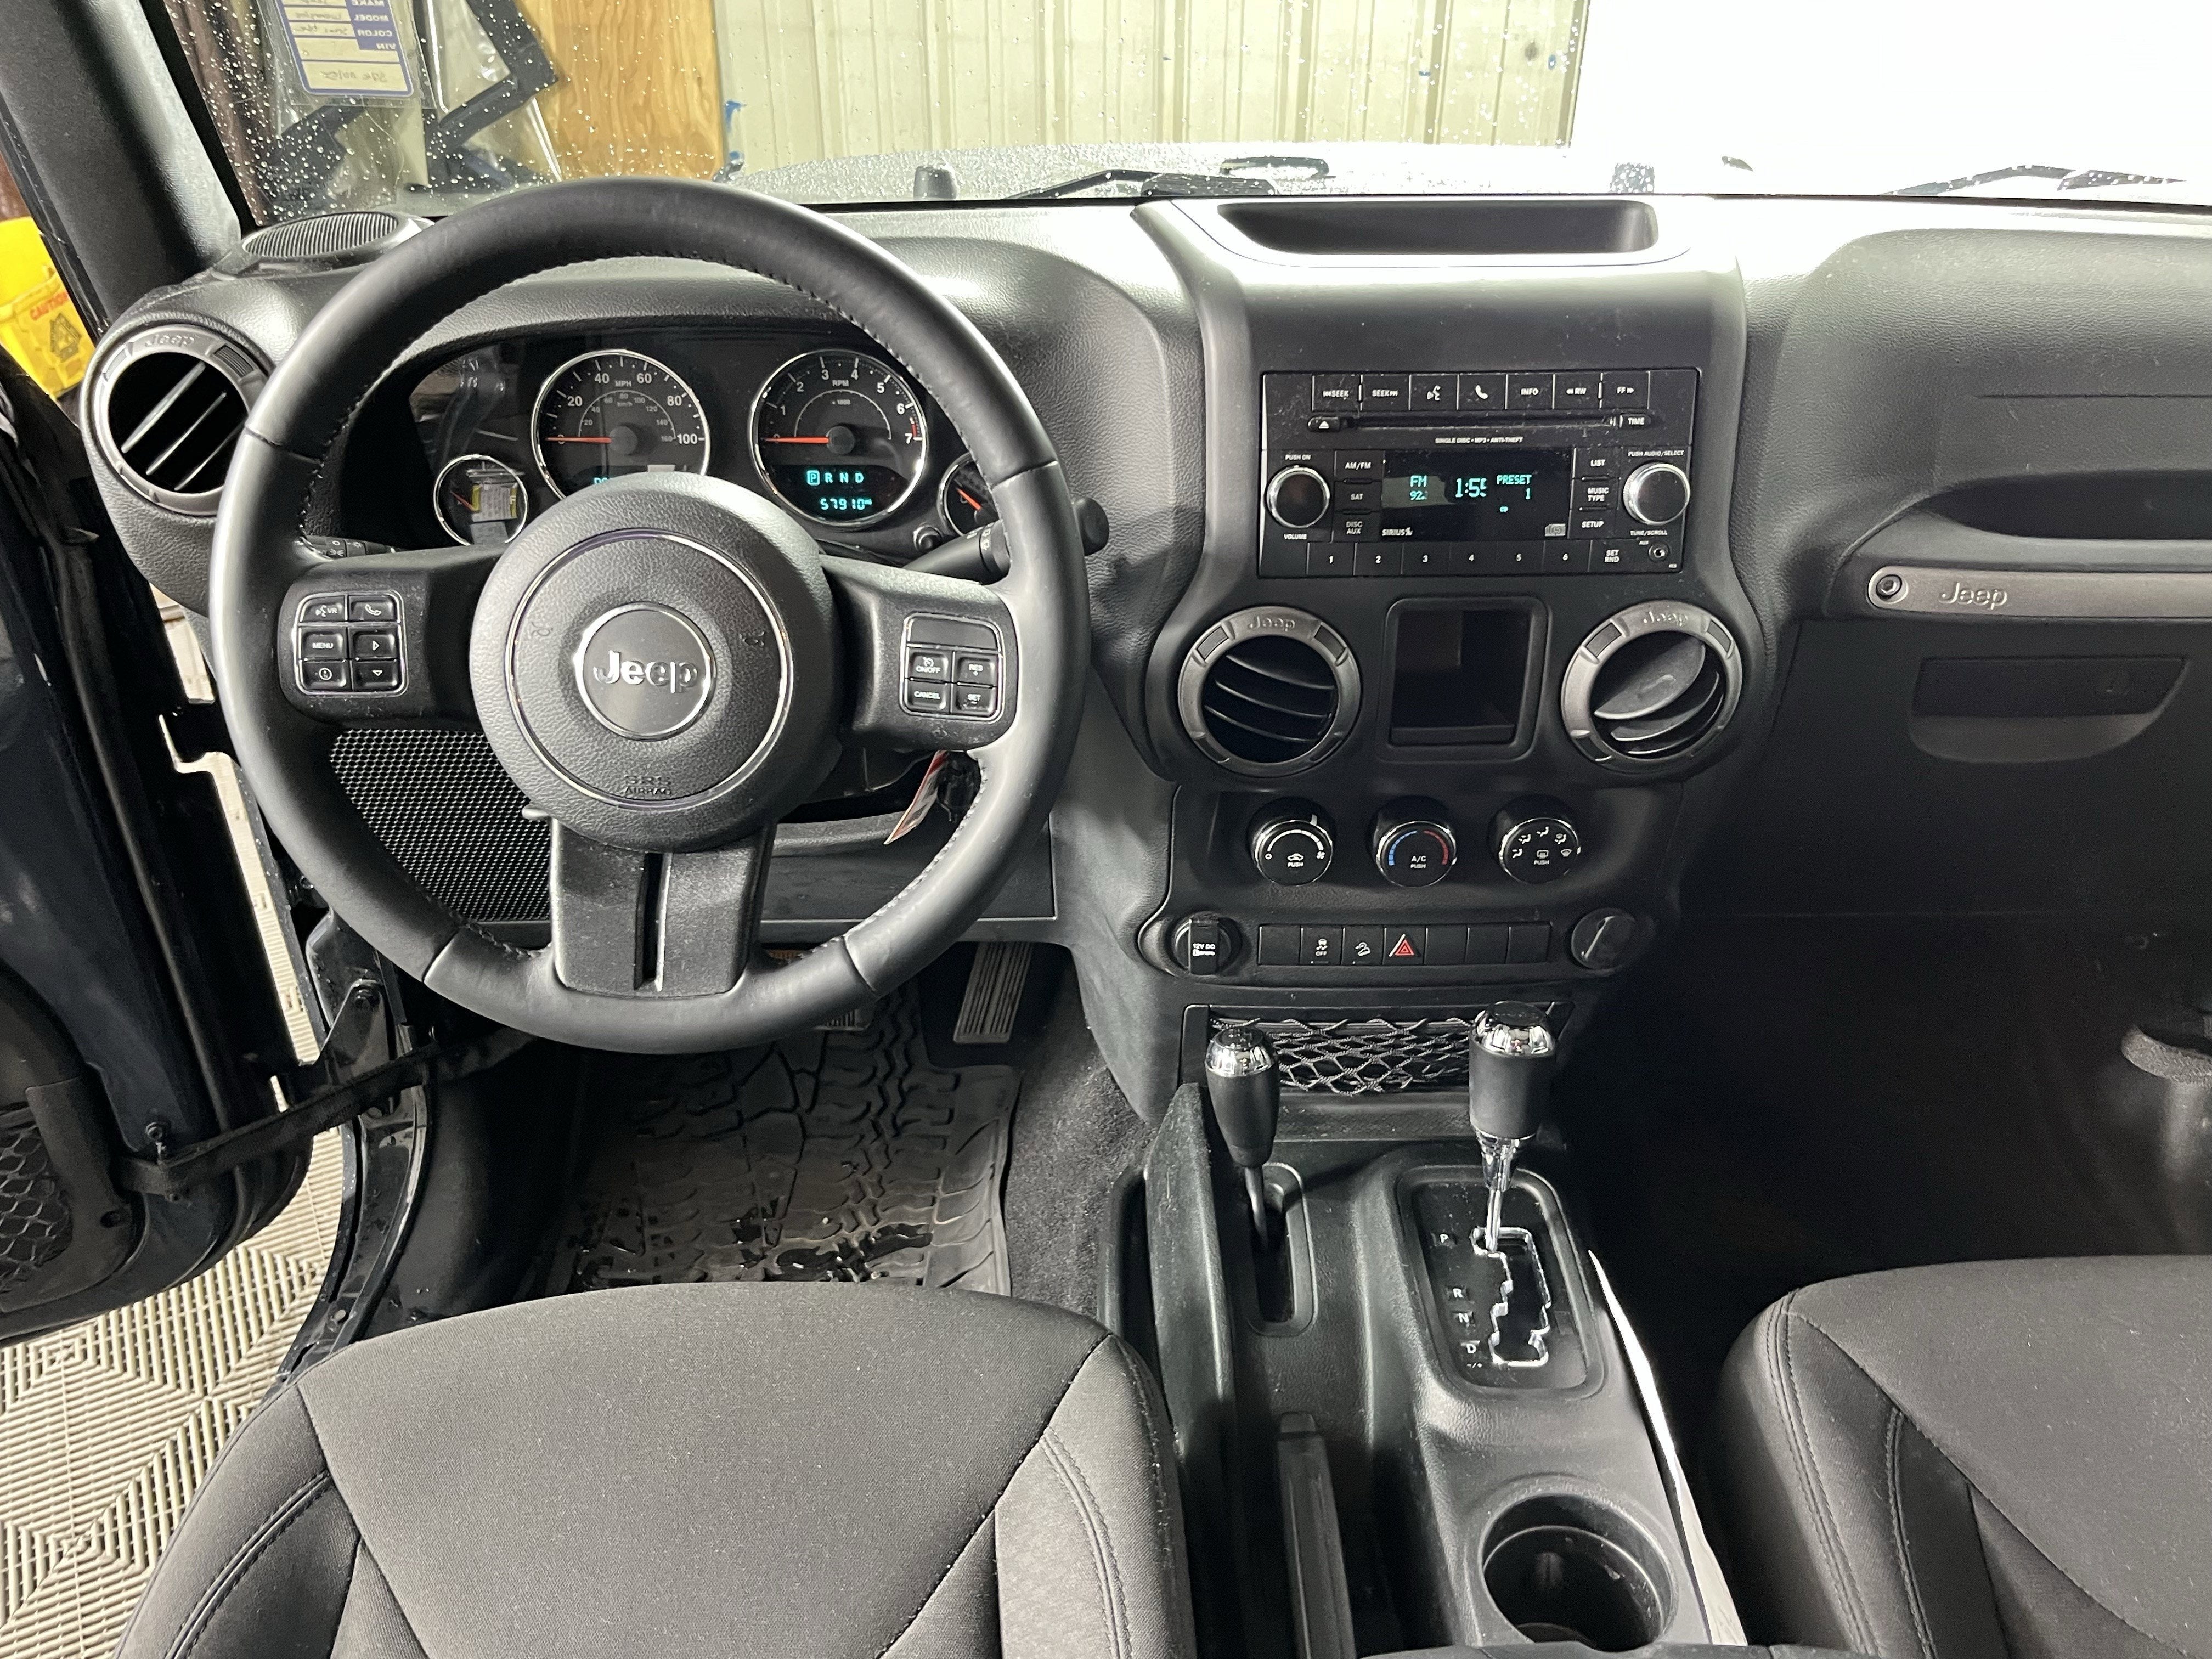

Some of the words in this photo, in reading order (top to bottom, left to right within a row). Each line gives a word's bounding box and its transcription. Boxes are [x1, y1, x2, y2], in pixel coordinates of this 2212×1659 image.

[595, 373, 610, 384] 40
[636, 373, 652, 384] 60
[822, 369, 829, 380] 3
[851, 369, 859, 380] 4
[797, 382, 804, 392] 2
[877, 382, 885, 393] 5
[567, 396, 583, 407] 20
[667, 395, 682, 406] 80
[780, 405, 786, 415] 1
[896, 403, 905, 414] 6
[677, 433, 697, 444] 100
[905, 433, 913, 444] 7
[825, 472, 833, 483] R
[839, 472, 849, 483] N
[855, 472, 864, 483] D
[1410, 475, 1427, 487] FM
[1497, 474, 1532, 484] PRESET
[1526, 488, 1531, 500] 1
[820, 498, 865, 510] 57910
[1942, 582, 2008, 610] Jeep
[1248, 615, 1296, 632] Jeep
[593, 650, 698, 693] Jeep
[969, 663, 983, 672] RES
[914, 690, 940, 699] CANCEL
[968, 693, 981, 702] SET
[1440, 1233, 1449, 1243] P
[1453, 1288, 1463, 1298] R
[1458, 1313, 1469, 1323] N
[1466, 1343, 1477, 1354] D
